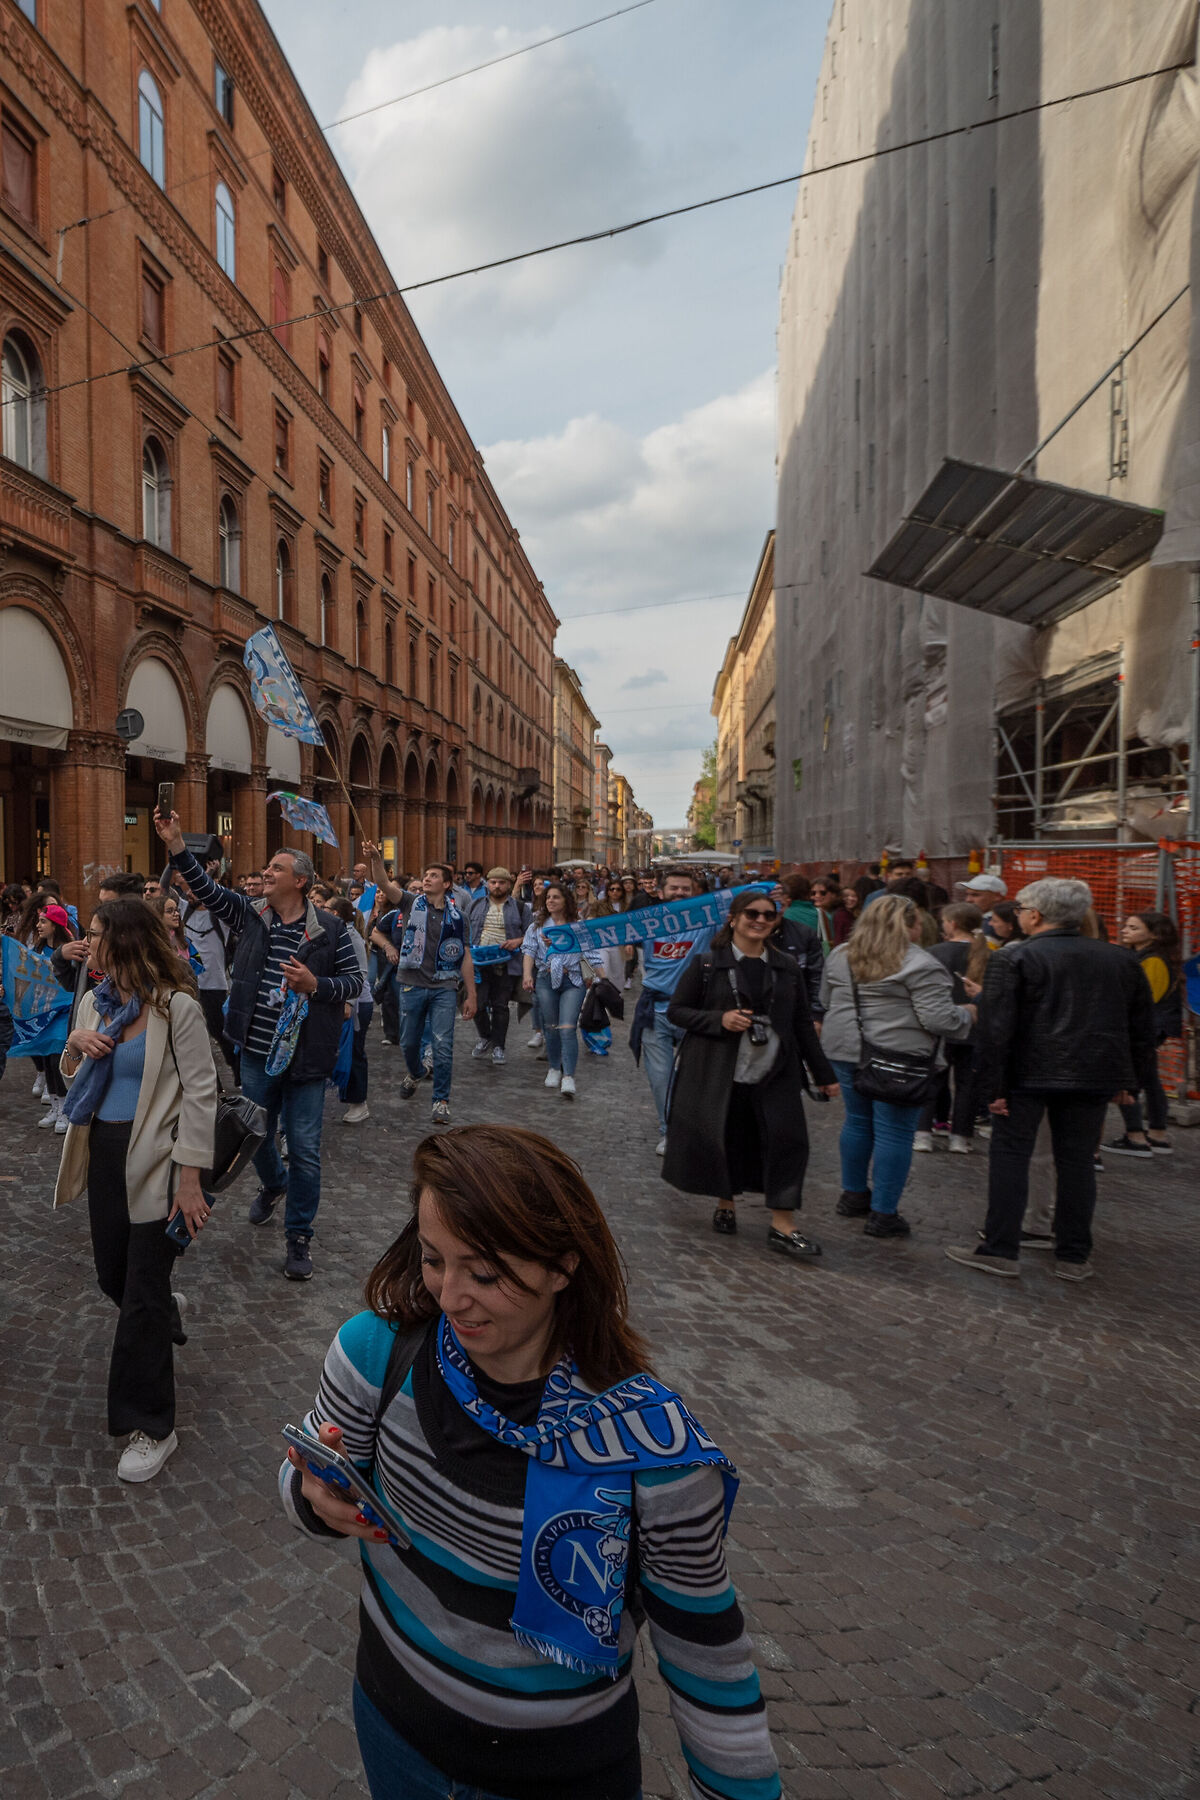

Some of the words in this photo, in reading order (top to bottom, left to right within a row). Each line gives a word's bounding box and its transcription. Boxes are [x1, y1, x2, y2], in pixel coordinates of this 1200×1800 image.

[594, 904, 717, 947] NAPOLI
[626, 906, 671, 922] FORZA
[563, 1538, 610, 1596] N
